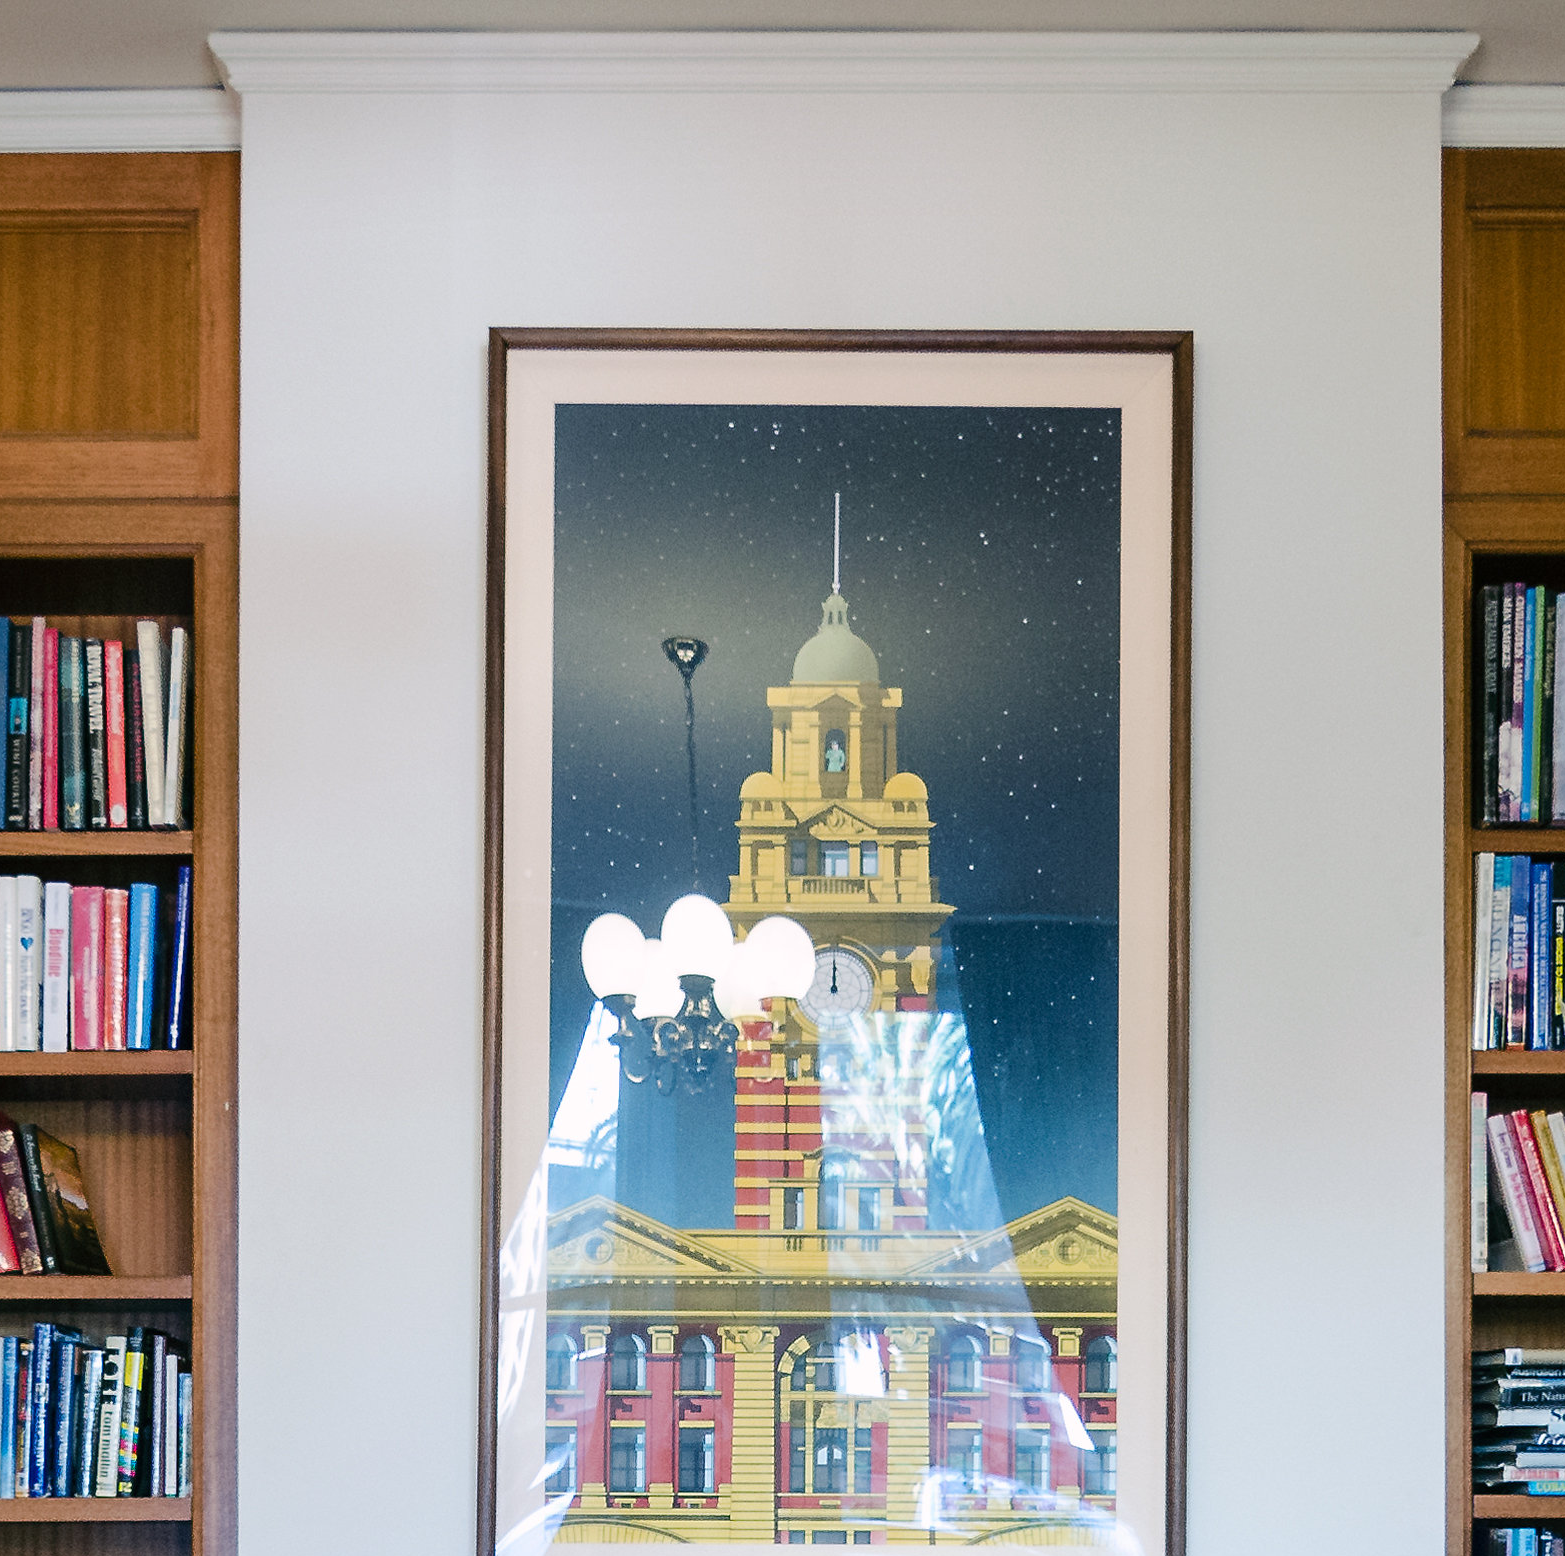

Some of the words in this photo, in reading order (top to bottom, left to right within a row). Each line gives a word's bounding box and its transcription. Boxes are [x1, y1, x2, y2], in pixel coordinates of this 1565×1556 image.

[87, 645, 102, 686] ROYAL
[1487, 663, 1496, 694] TODAY
[88, 688, 104, 734] TRAVEL
[48, 928, 64, 978] Bloodline
[1512, 914, 1526, 969] AMERICA
[1511, 1367, 1559, 1378] Australian
[1519, 1391, 1540, 1404] The
[1525, 1534, 1533, 1552] THE
